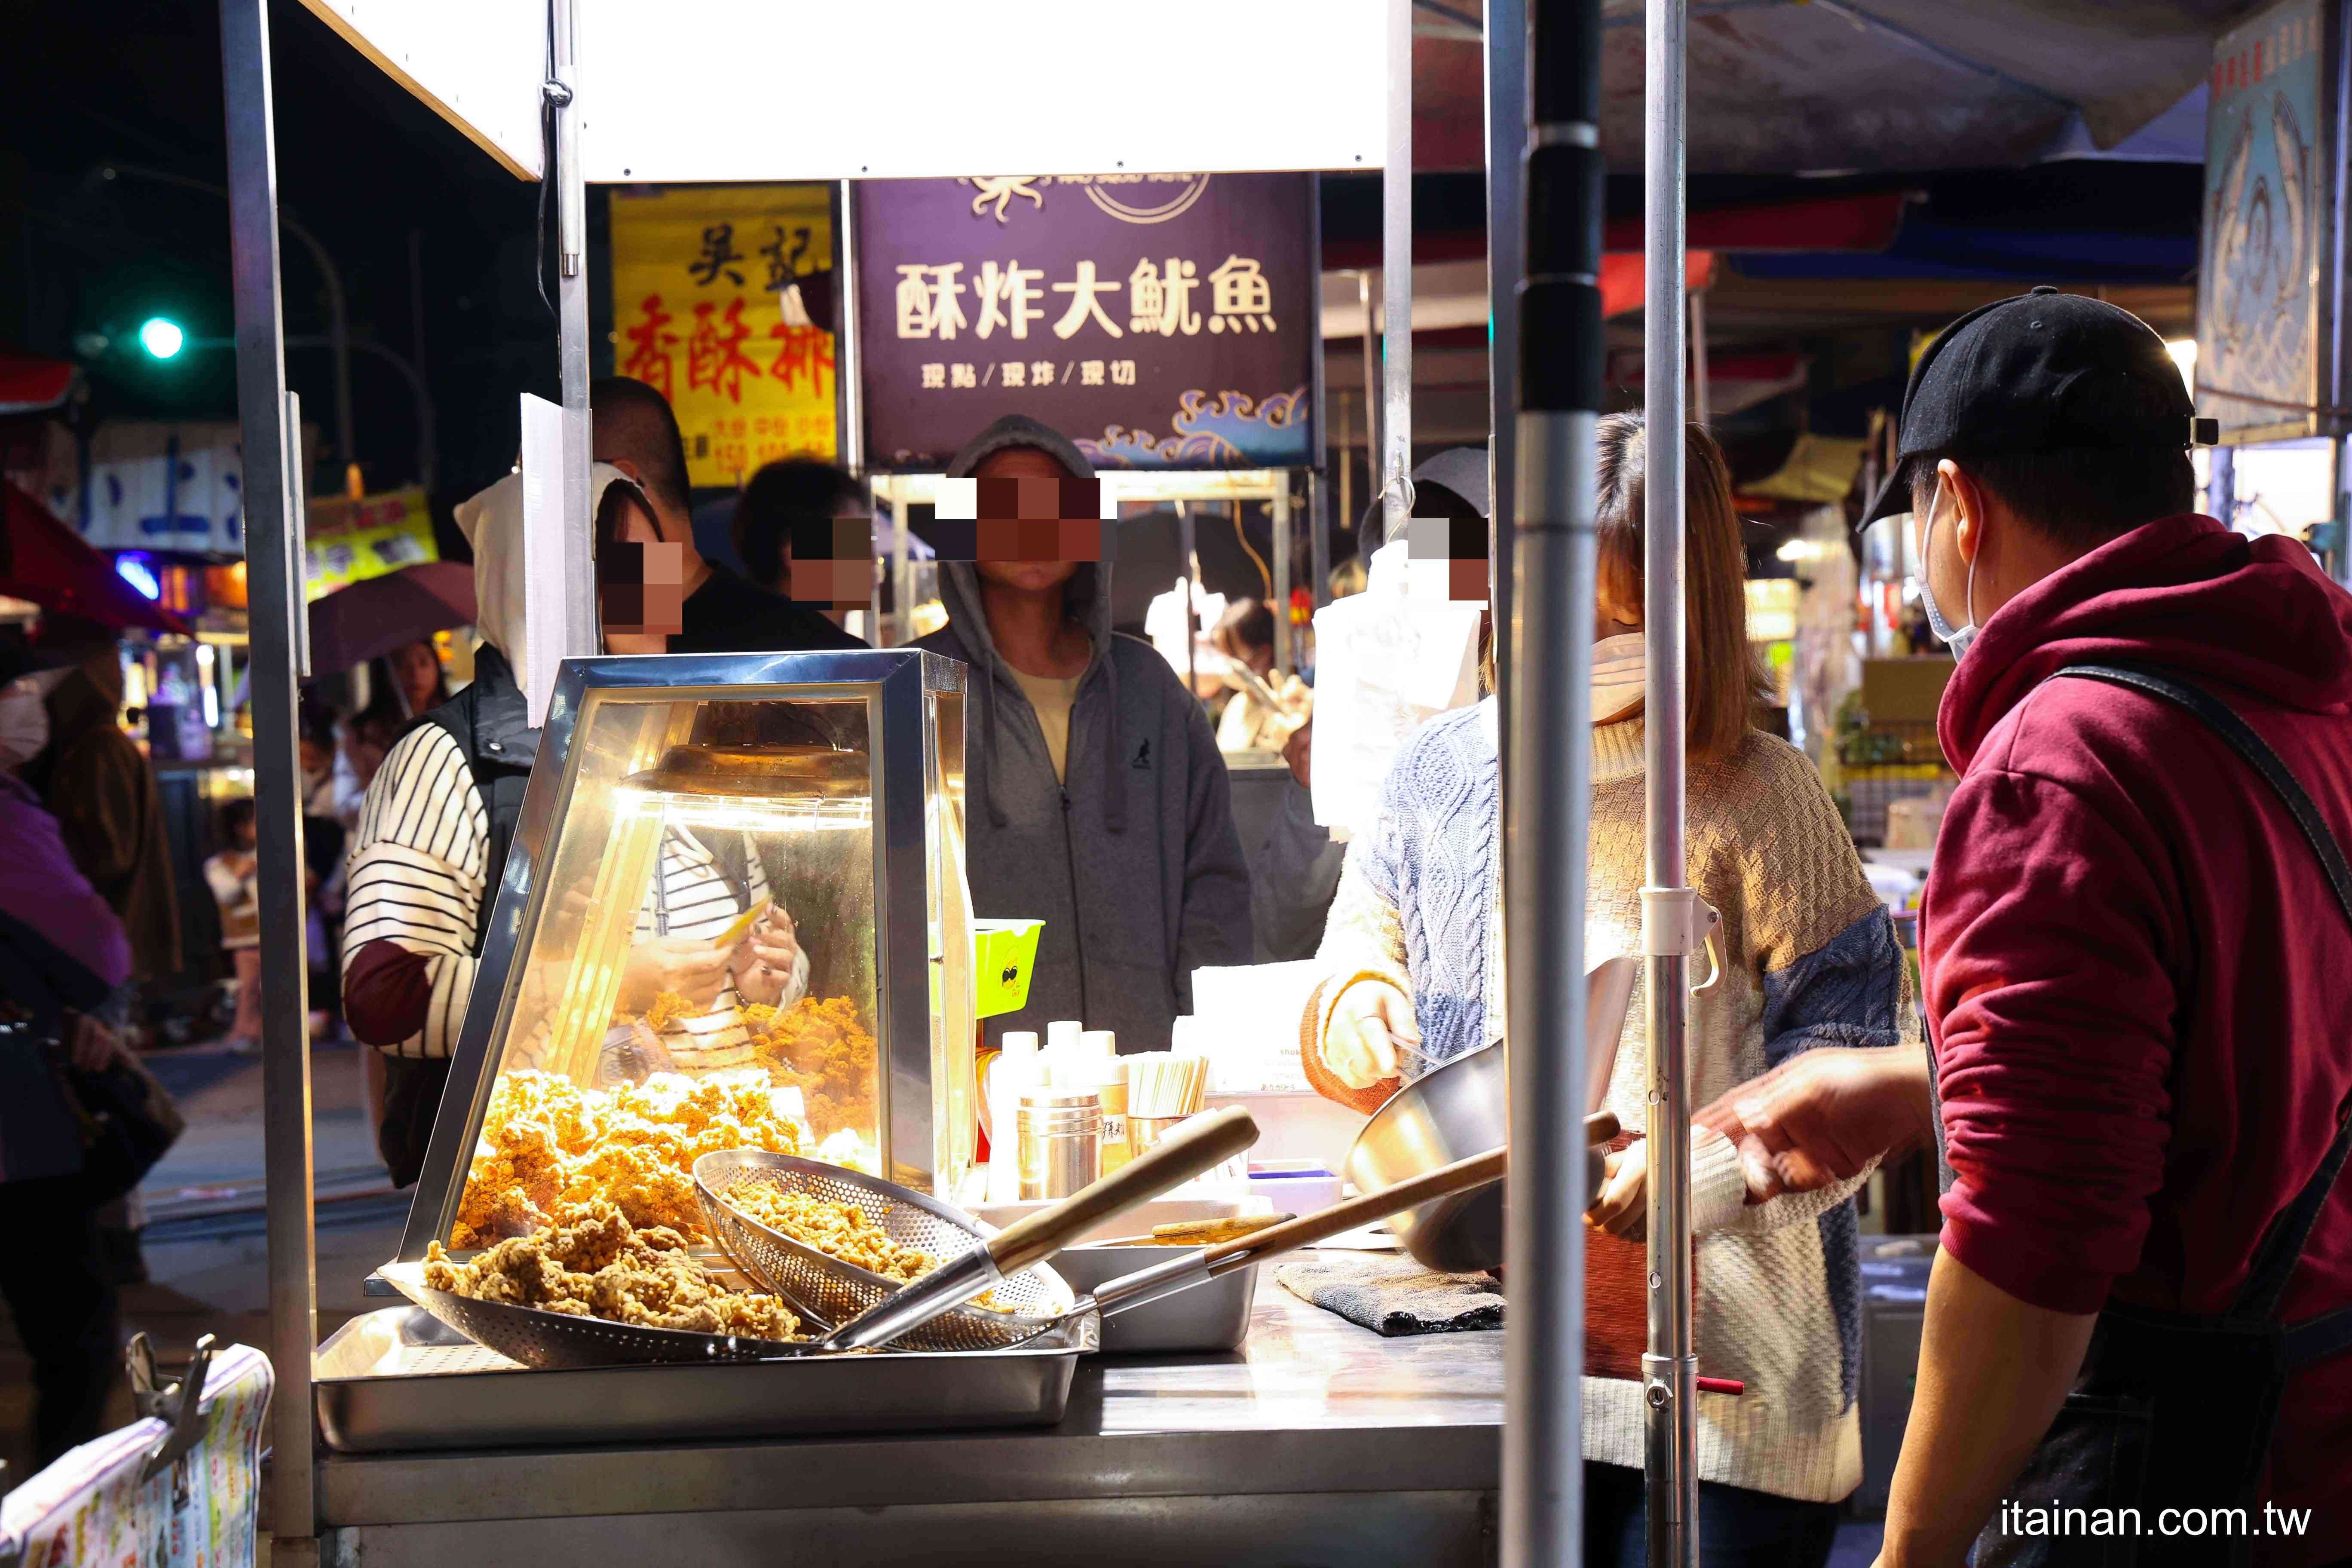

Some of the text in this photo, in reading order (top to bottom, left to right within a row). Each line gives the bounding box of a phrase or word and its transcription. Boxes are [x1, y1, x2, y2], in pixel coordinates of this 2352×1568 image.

[895, 254, 1277, 340] 酥炸大魷魚
